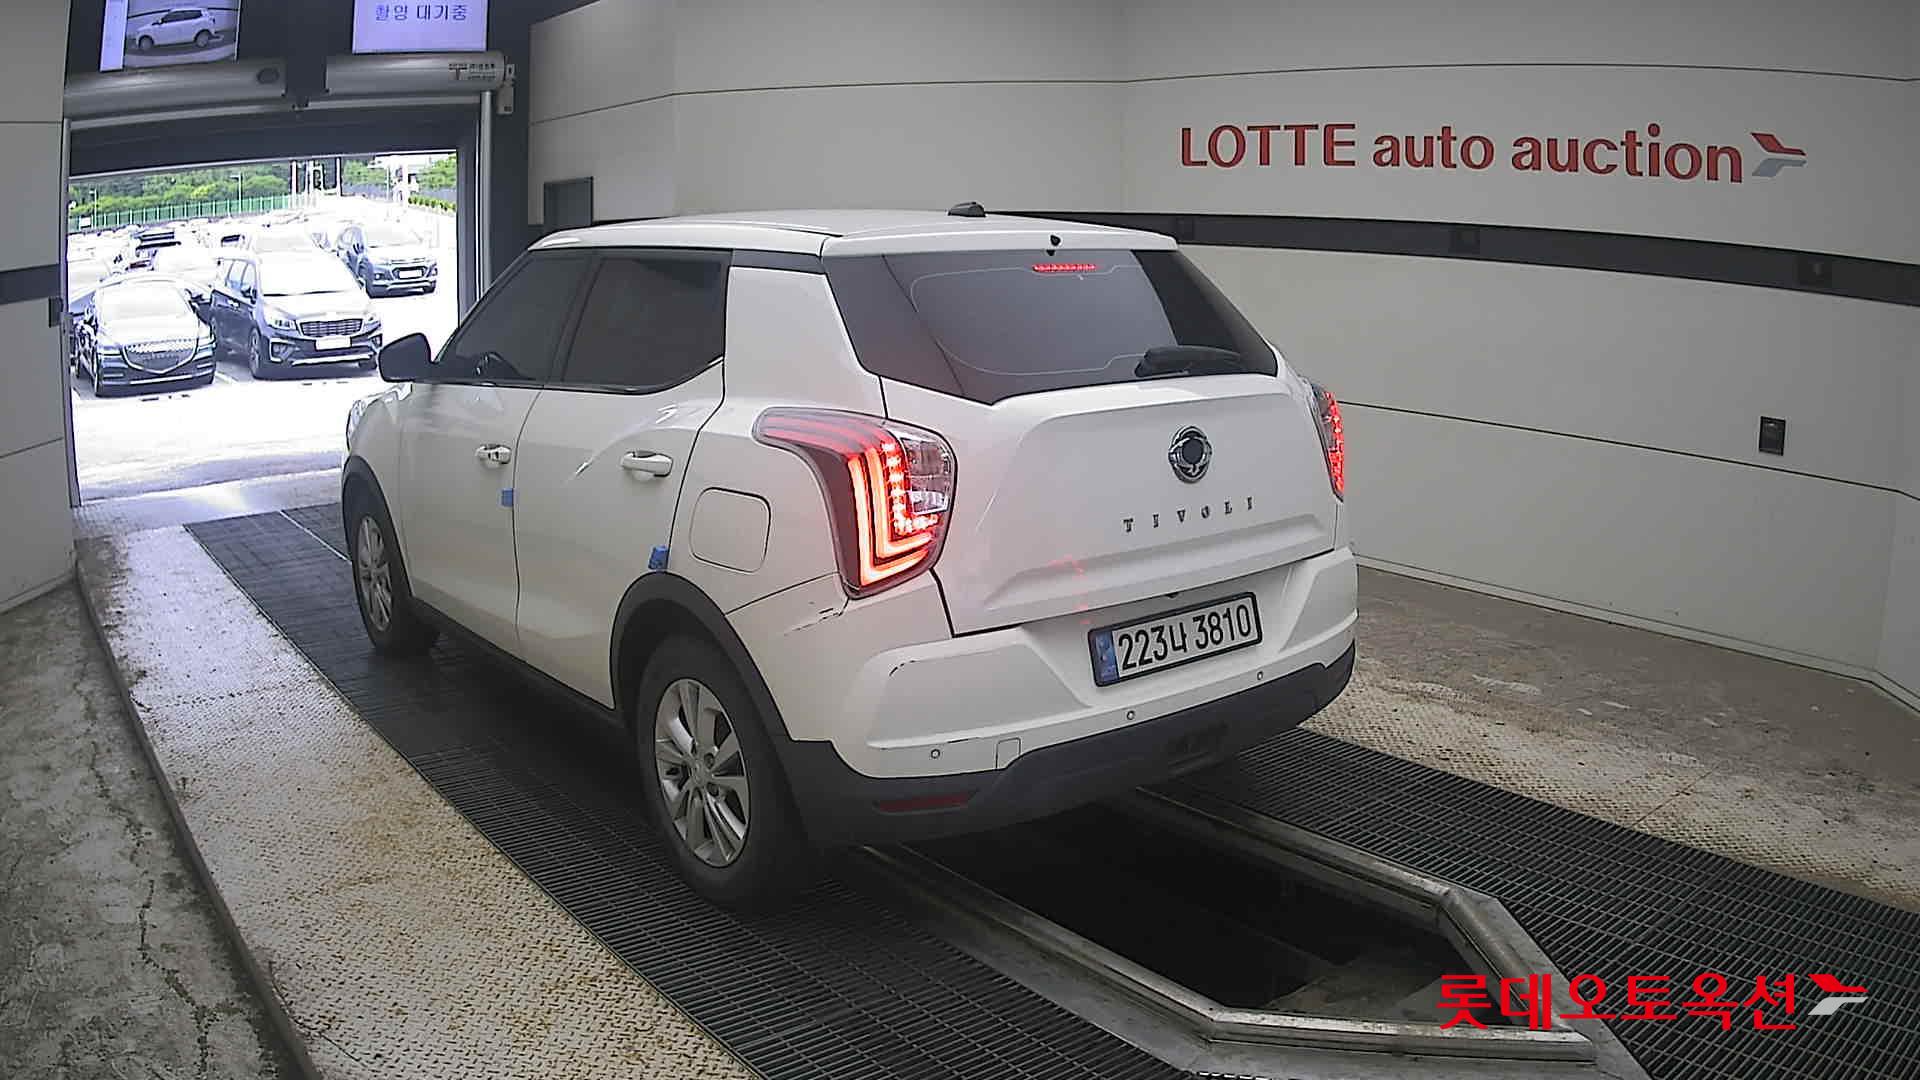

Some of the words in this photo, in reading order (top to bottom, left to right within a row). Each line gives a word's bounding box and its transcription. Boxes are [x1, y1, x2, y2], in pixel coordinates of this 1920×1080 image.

[416, 4, 467, 21] 대기중
[1180, 123, 1357, 168] LOTTE
[1372, 125, 1495, 170] auto
[1511, 122, 1743, 184] auction
[1123, 496, 1254, 533] TIVOLI
[1118, 622, 1188, 671] 223나
[1192, 603, 1252, 650] 3810
